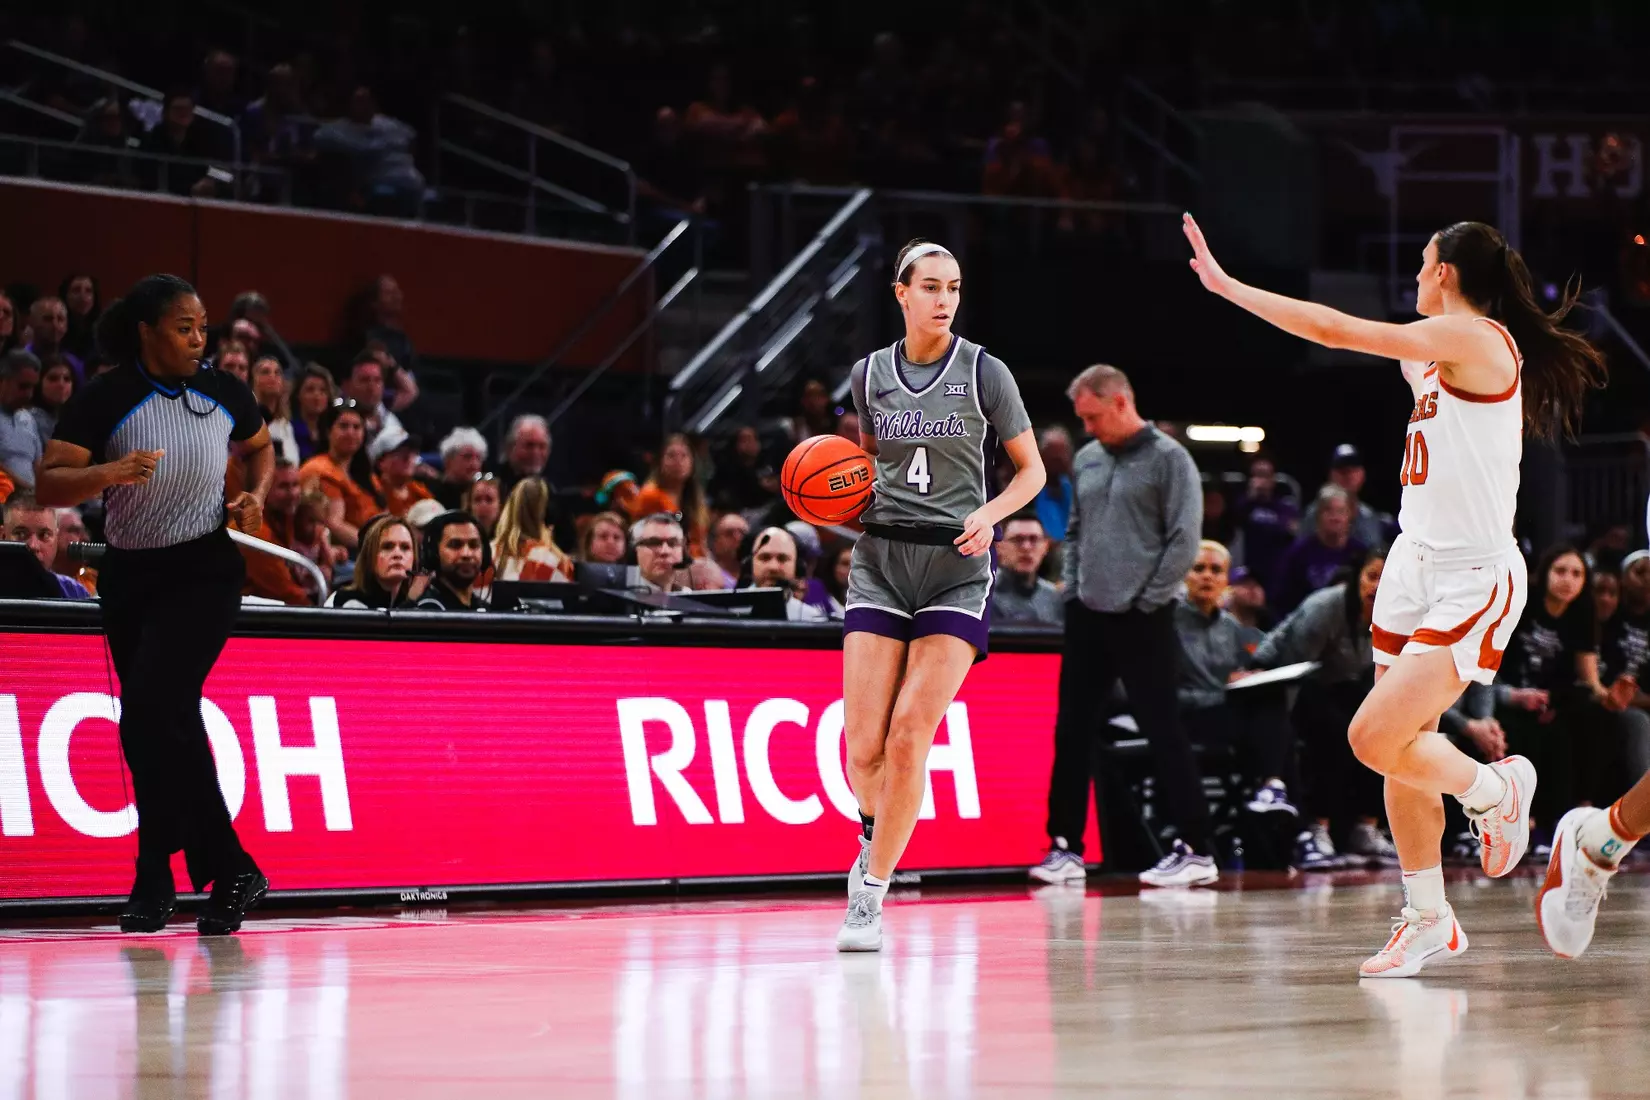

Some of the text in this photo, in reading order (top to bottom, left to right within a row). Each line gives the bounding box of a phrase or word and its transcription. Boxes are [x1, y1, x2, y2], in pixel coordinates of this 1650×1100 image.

[875, 410, 967, 440] Wildcats
[906, 446, 932, 496] 4
[1401, 431, 1429, 486] 10
[828, 467, 870, 492] ELITE
[400, 891, 448, 902] DAKTRONICS
